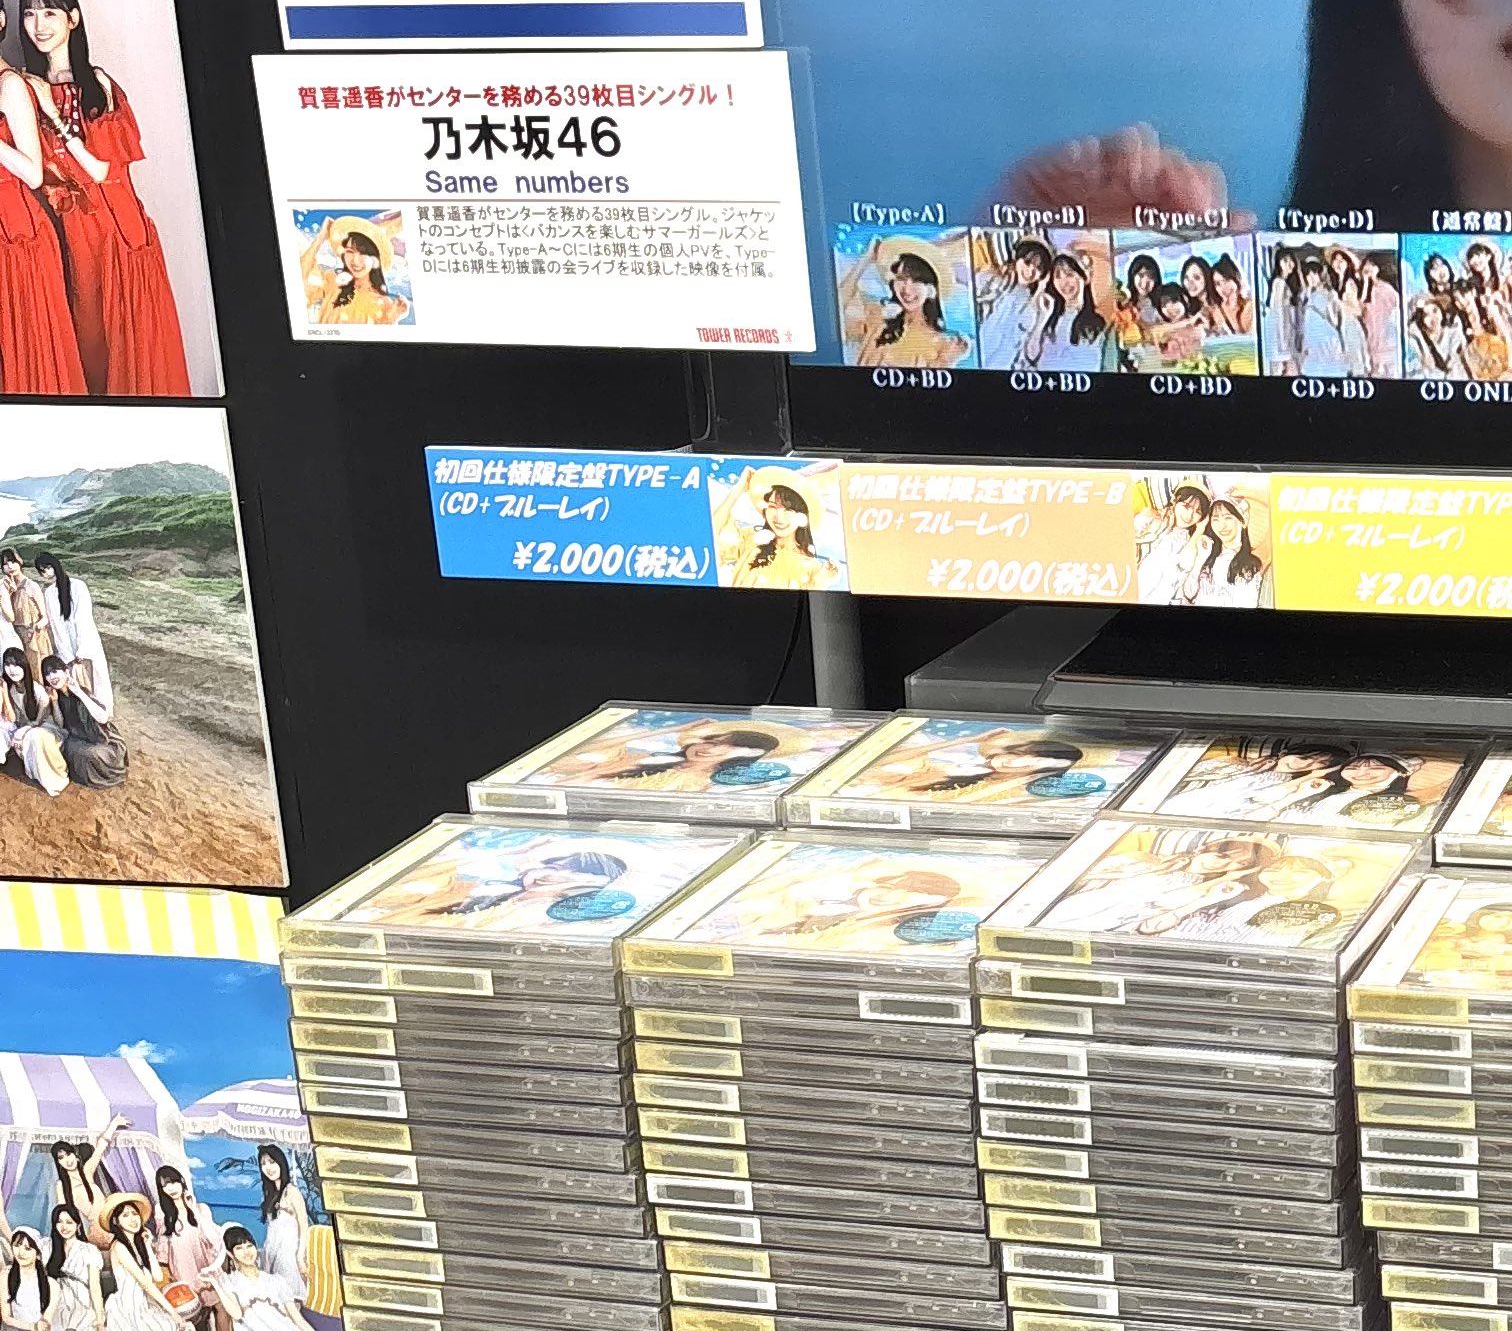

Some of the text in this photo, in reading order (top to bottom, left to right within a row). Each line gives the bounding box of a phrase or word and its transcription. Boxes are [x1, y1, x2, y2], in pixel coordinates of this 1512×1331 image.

[297, 83, 735, 110] 賀喜遥香がセンターを務める39枚目シングル！
[421, 114, 622, 161] 乃木坂46
[425, 170, 631, 195] Same numbers
[873, 369, 953, 391] CD+BD
[1010, 371, 1092, 394] CD+BD
[1150, 374, 1233, 398] CD+BD
[1290, 379, 1376, 402] CD+BD
[1420, 380, 1455, 403] CD
[434, 458, 701, 491] 初回仕様限定盤TYPE-A
[512, 540, 711, 580] ¥2,000(税込)
